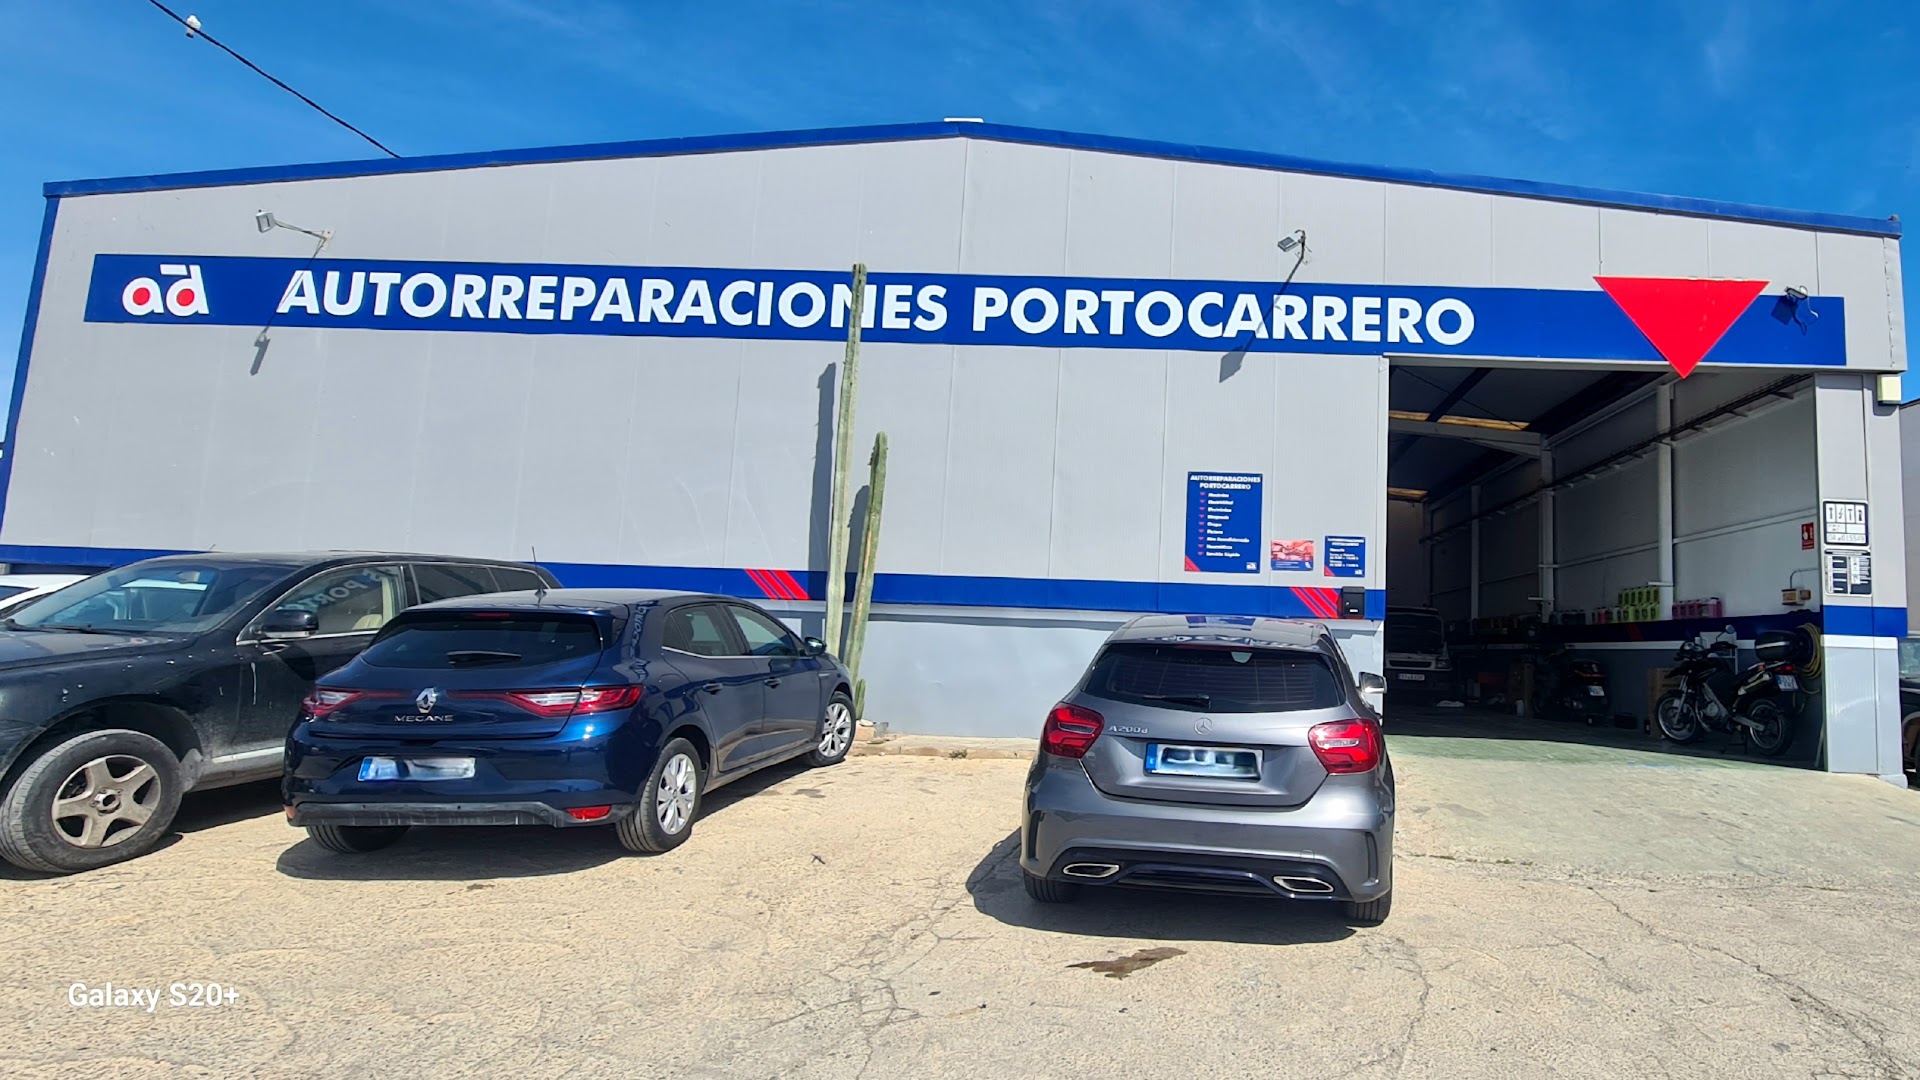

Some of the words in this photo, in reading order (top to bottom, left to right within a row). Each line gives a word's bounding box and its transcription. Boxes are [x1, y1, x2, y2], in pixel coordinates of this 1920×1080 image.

[276, 270, 948, 332] AUTORREPARACIONES
[972, 286, 1475, 346] PORTOCARRERO
[1190, 475, 1261, 483] AUTORREPARACIONES
[1199, 482, 1252, 490] PORTOCARRERO
